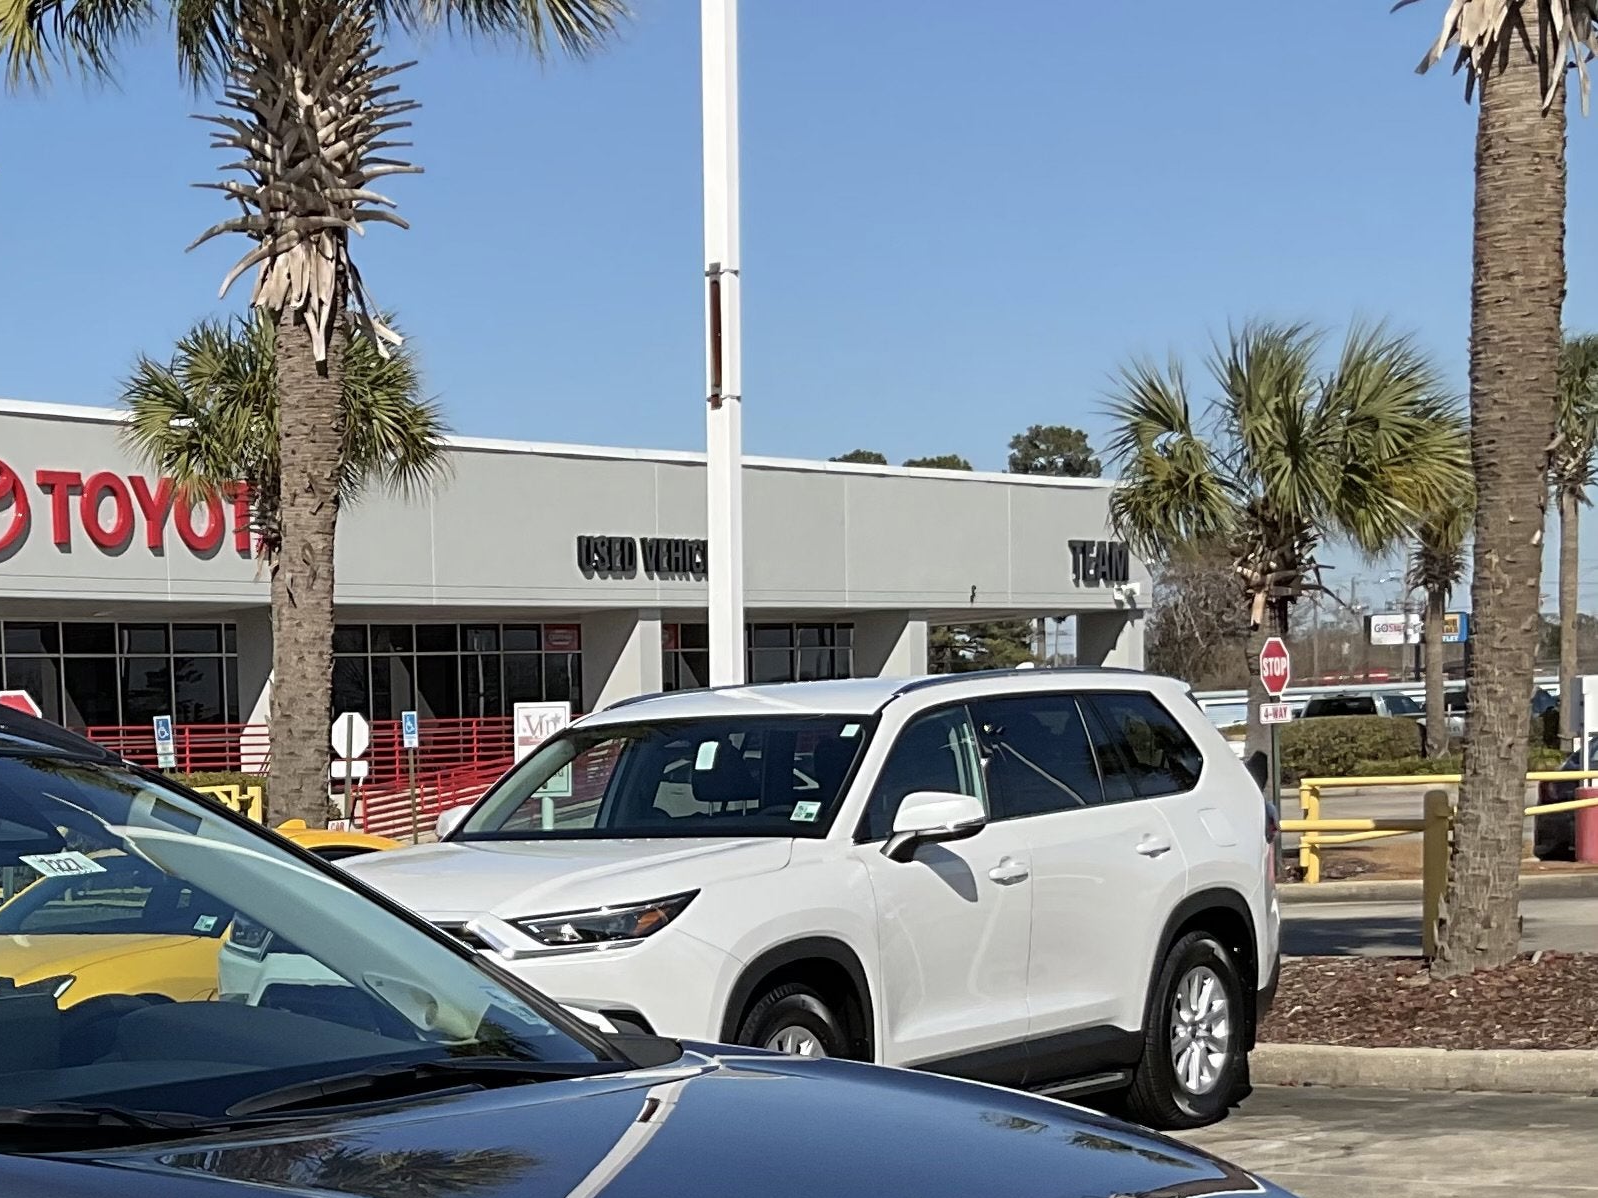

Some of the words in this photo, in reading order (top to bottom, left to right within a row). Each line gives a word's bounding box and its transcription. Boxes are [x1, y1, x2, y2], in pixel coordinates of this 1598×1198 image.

[36, 470, 254, 553] TOYOT
[577, 535, 637, 577] USED
[640, 537, 708, 578] VEHIC
[1068, 540, 1129, 584] TEAM
[1262, 656, 1287, 677] STOP
[1264, 706, 1288, 720] 4-WAY
